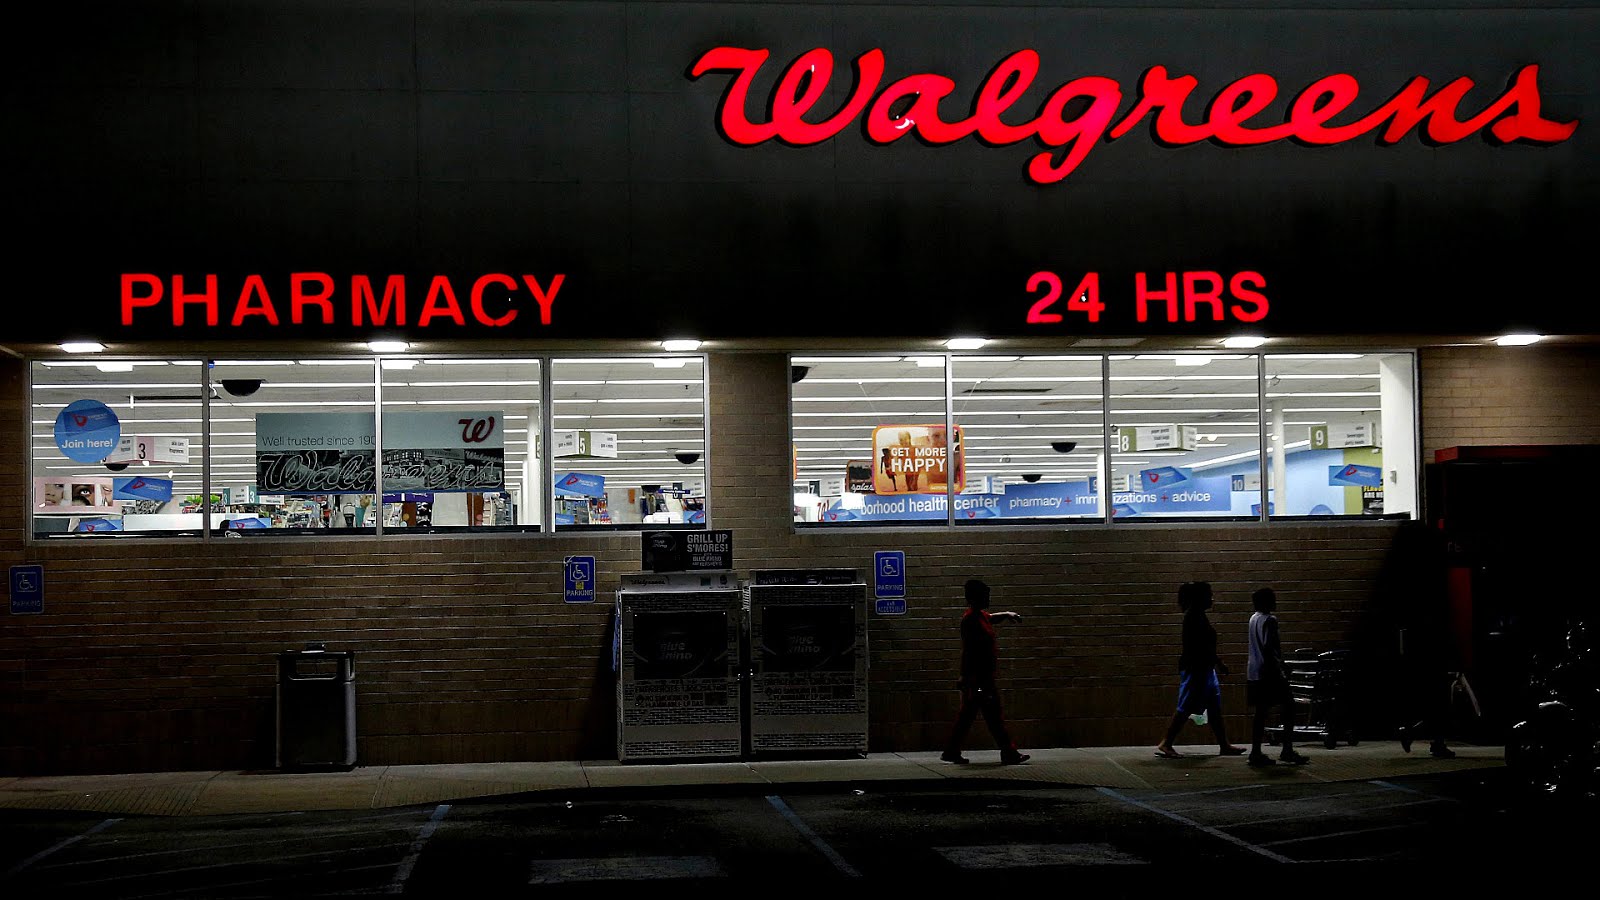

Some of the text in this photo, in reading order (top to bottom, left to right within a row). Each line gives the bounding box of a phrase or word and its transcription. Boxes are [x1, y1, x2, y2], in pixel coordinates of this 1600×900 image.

[690, 45, 1578, 184] Walgreens
[120, 272, 566, 327] PHARMACY
[1026, 270, 1269, 324] 24 HRS
[61, 439, 84, 449] Join
[87, 438, 113, 448] here!
[262, 435, 377, 446] Well trusted since 190
[1121, 435, 1130, 452] 8
[1316, 430, 1324, 446] 9
[138, 442, 146, 460] 3
[579, 437, 586, 455] 5
[891, 447, 946, 457] GET MORE
[891, 458, 946, 473] HAPPY
[851, 482, 875, 493] splas
[1232, 479, 1244, 491] 10
[249, 491, 255, 503] 3
[1010, 496, 1062, 510] pharmacy
[1172, 491, 1211, 502] advice
[861, 496, 1000, 516] borhood health center
[686, 533, 728, 544] GRILL UP
[686, 543, 729, 552] S'MORES!
[566, 589, 593, 597] PARKING
[876, 584, 903, 592] PARKING
